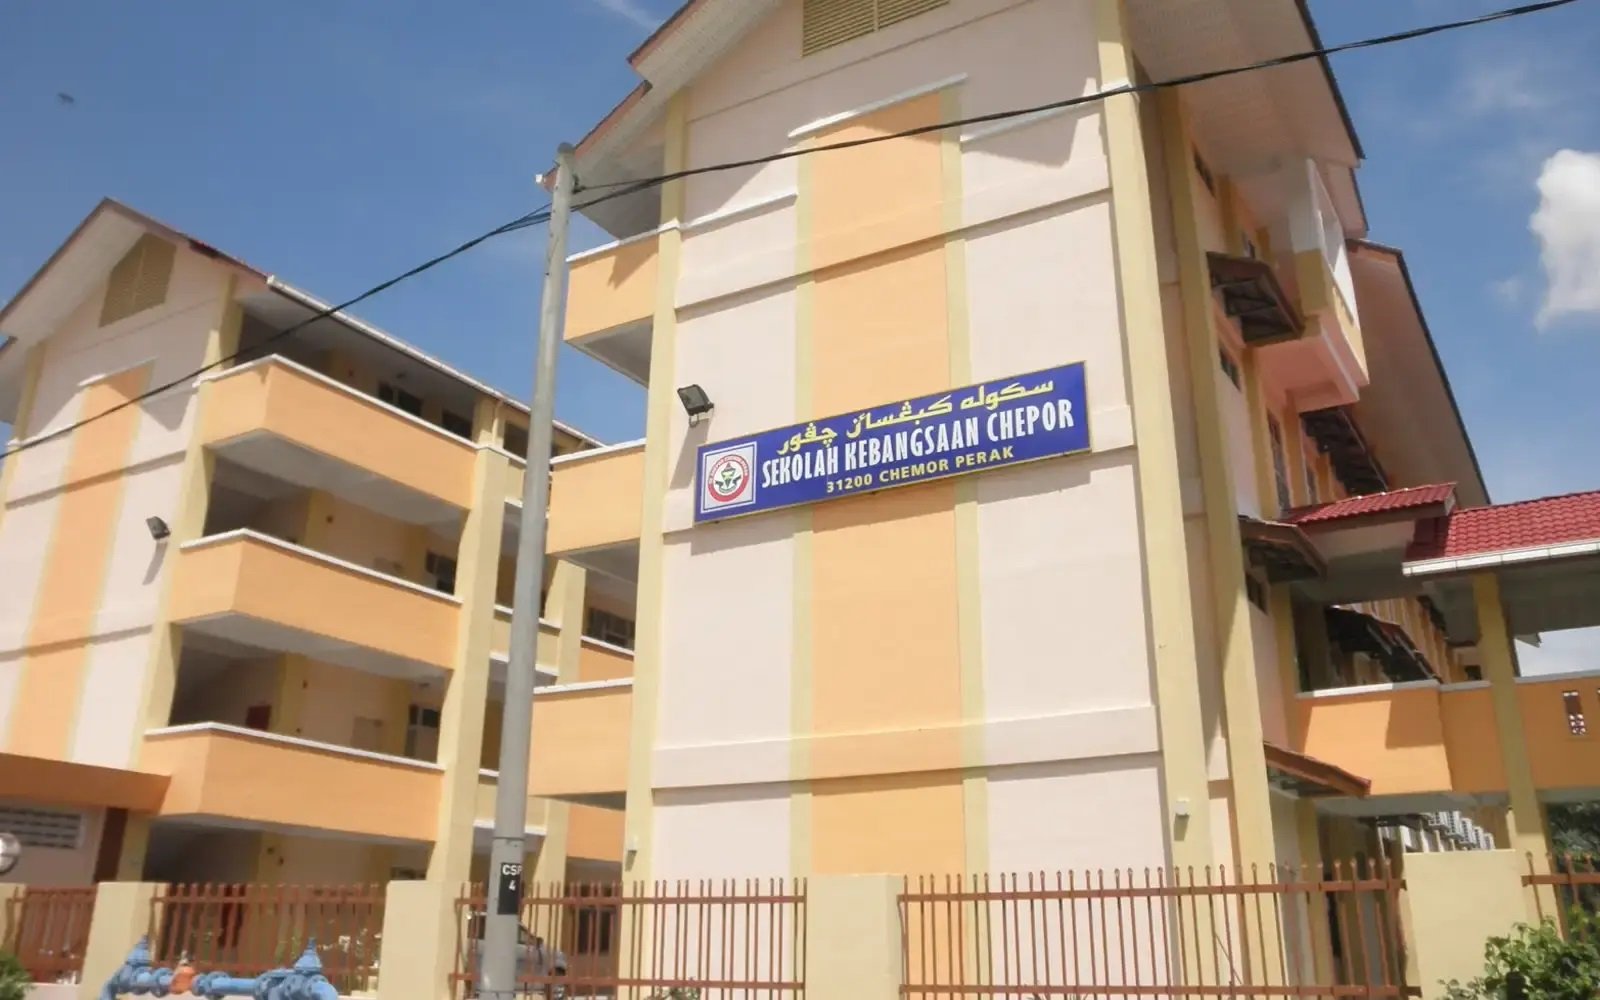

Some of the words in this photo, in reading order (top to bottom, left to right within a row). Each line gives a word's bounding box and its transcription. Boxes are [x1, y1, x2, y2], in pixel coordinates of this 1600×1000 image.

[762, 446, 839, 488] SEKOLAH
[845, 416, 979, 471] KEBANGSAAN
[987, 399, 1074, 442] CHEPOR
[826, 473, 873, 493] 31200
[879, 460, 949, 482] CHEMOR
[955, 445, 1014, 468] PERAK
[508, 880, 516, 891] 4
